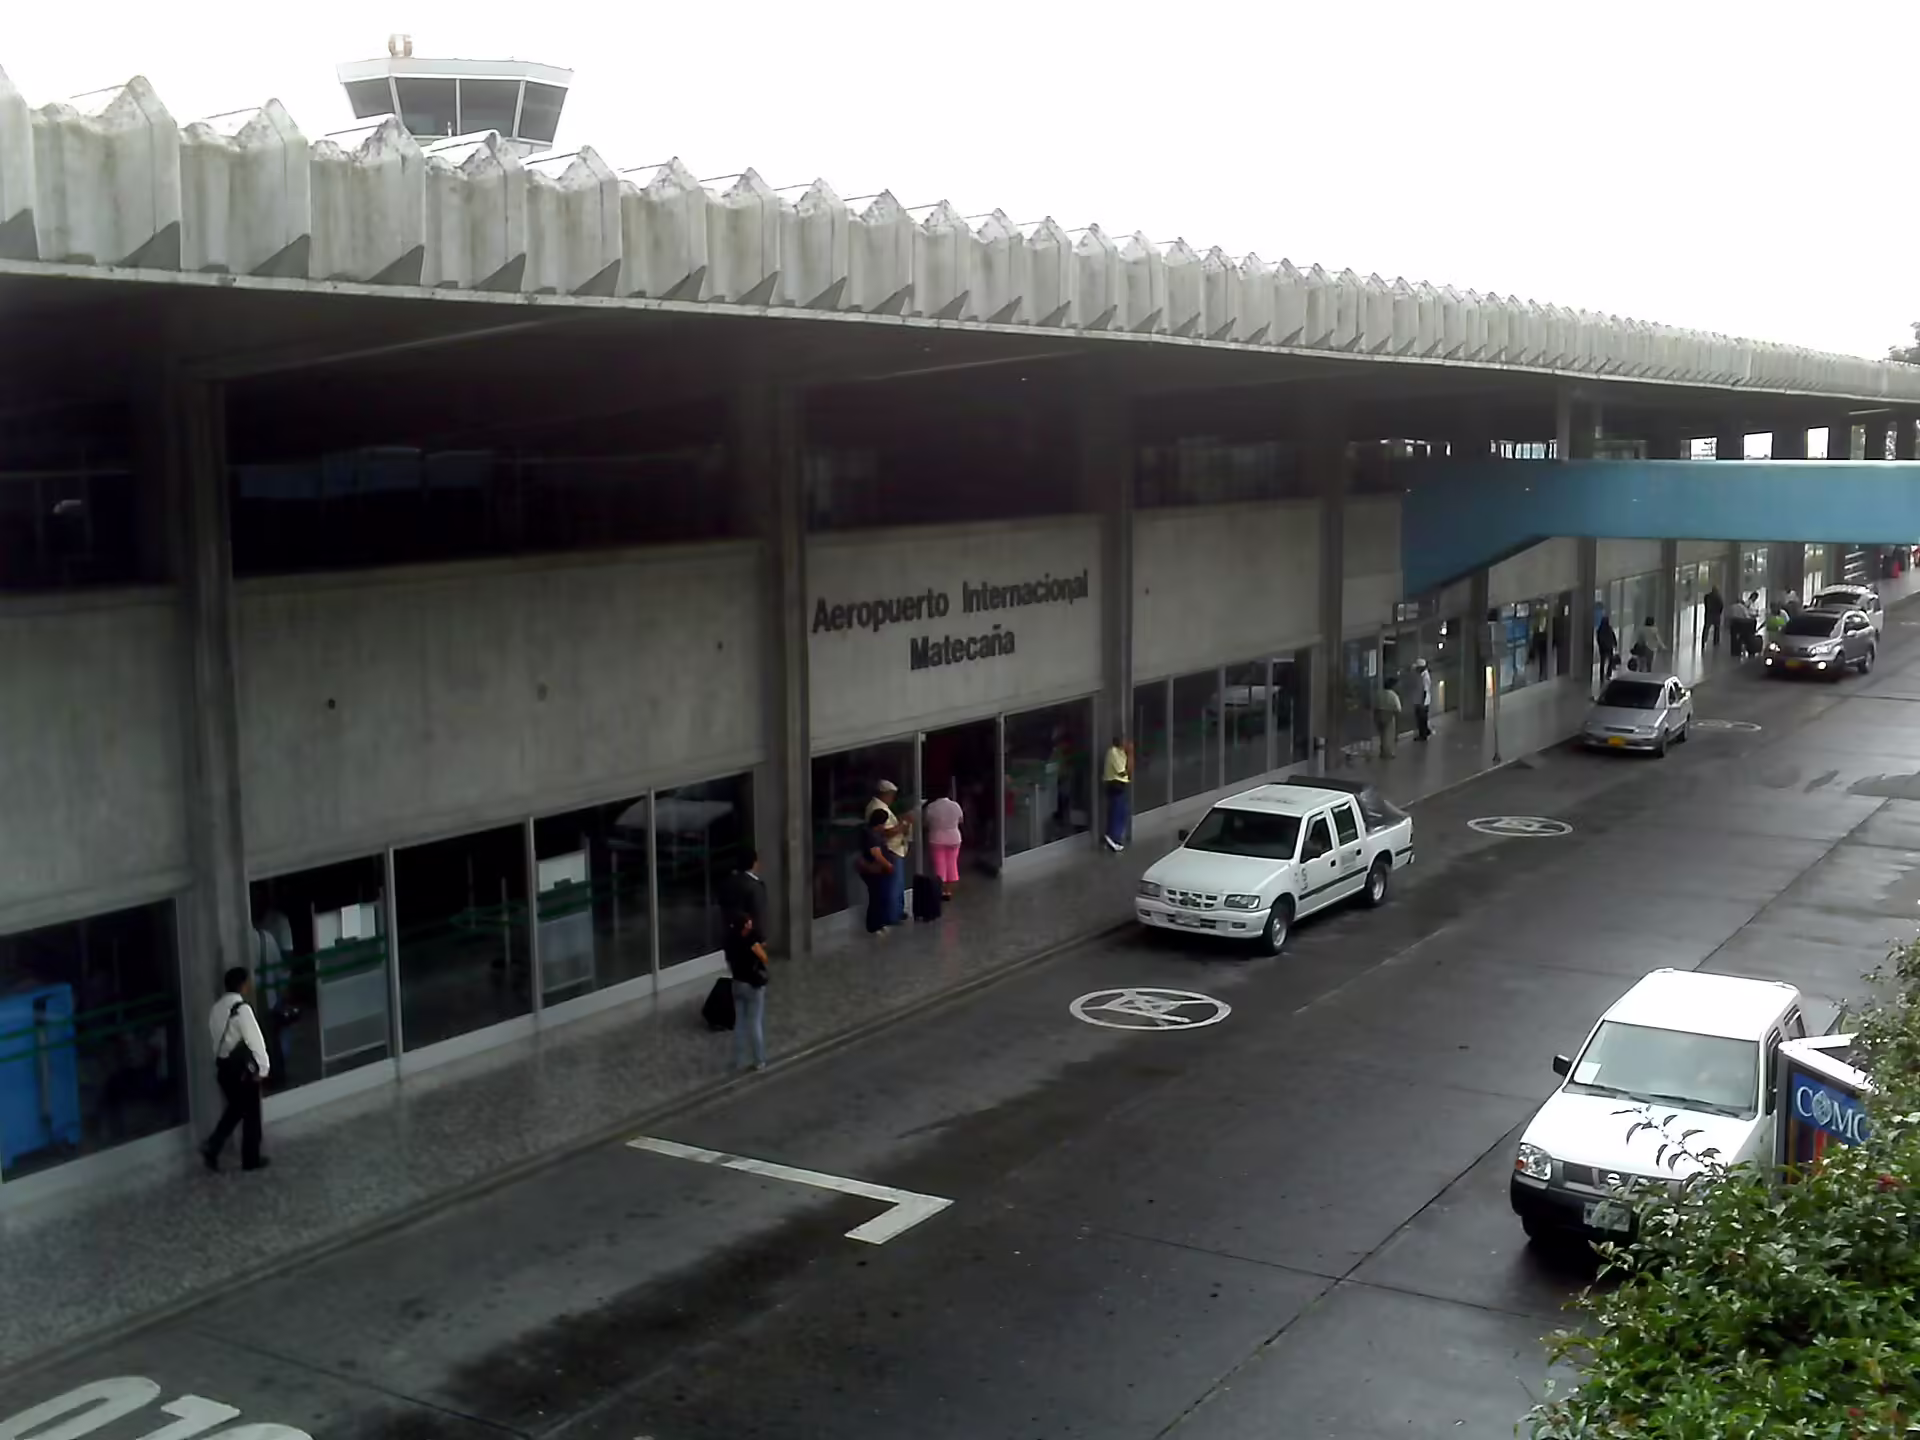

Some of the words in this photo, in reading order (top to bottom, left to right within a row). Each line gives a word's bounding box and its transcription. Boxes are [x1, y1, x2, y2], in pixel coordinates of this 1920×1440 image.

[811, 588, 949, 633] Aeropuerto
[962, 568, 1088, 613] Internacional
[910, 624, 1015, 670] Matecaña
